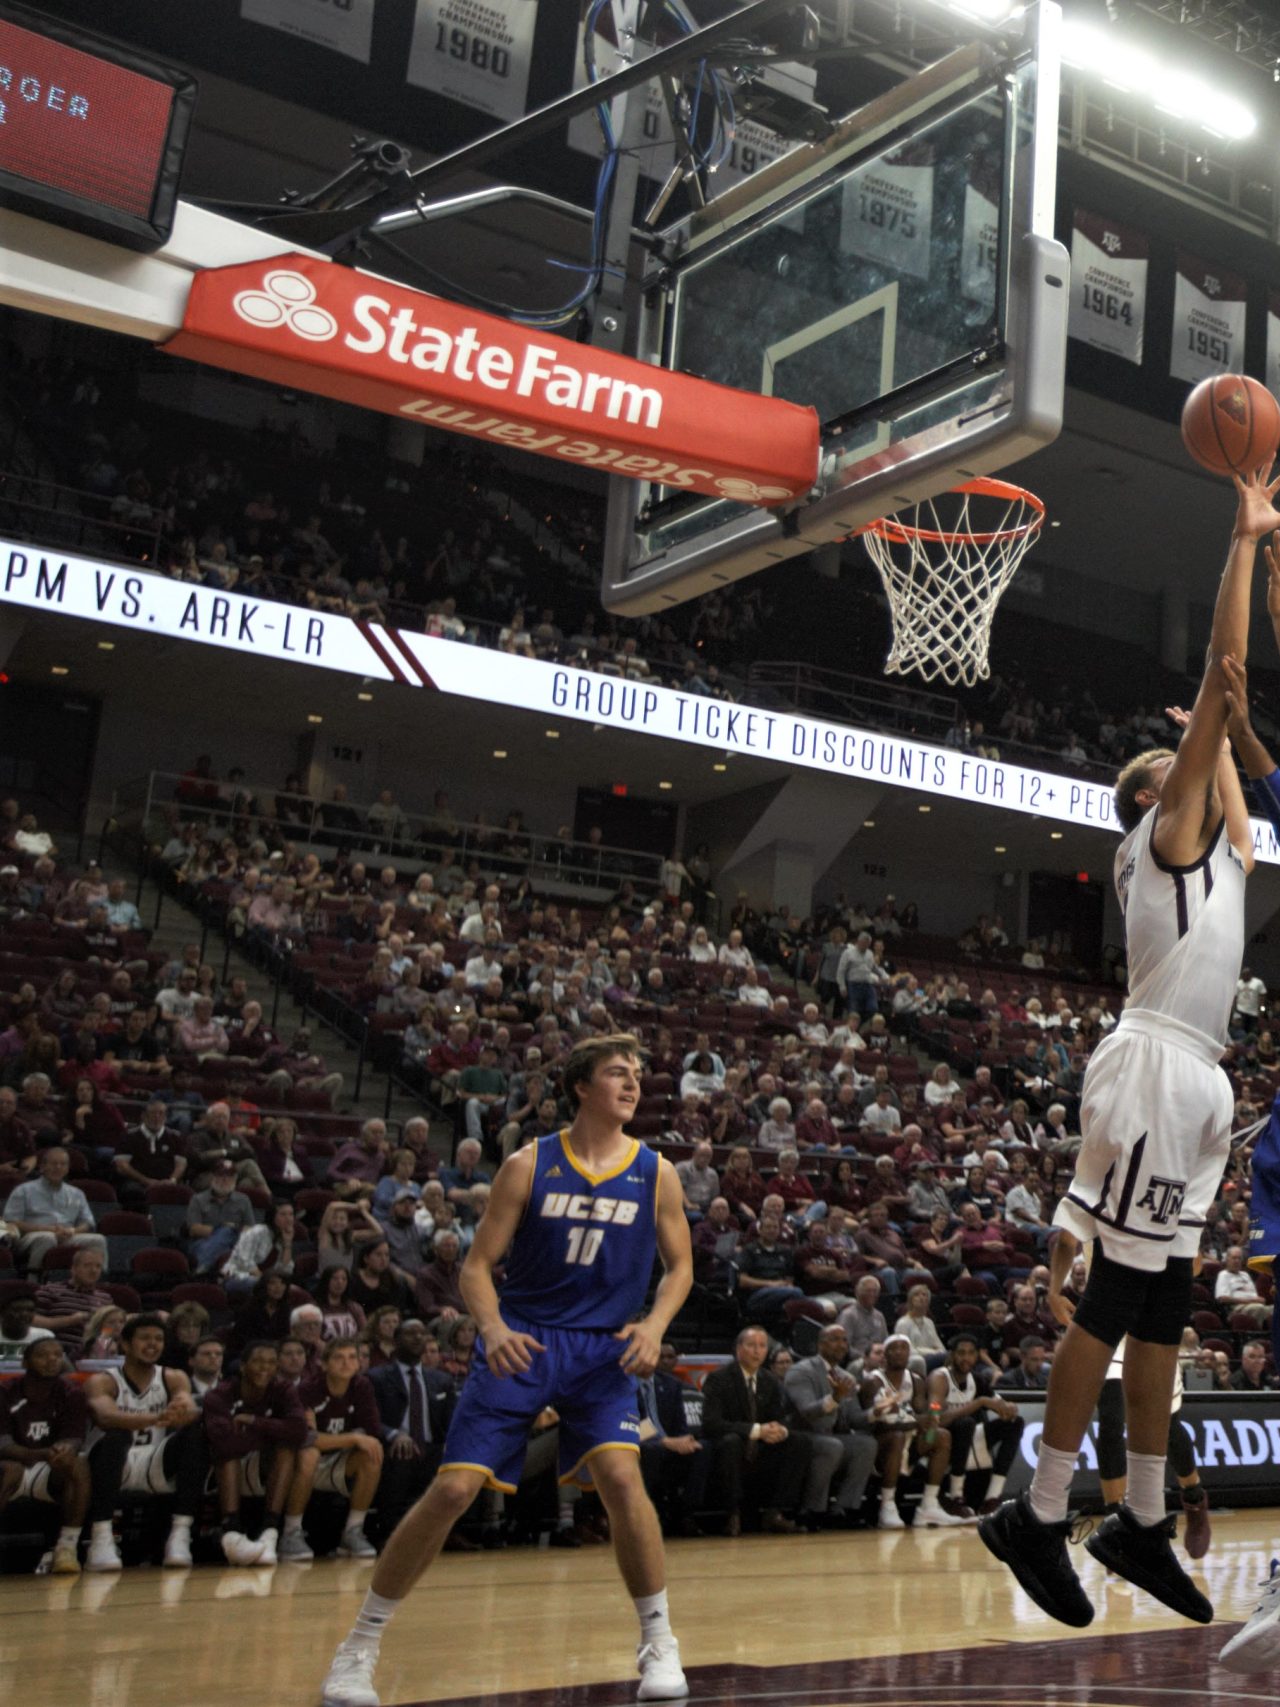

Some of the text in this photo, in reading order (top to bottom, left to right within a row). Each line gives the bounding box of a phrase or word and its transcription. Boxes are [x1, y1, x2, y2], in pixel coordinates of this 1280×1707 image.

[439, 7, 513, 45] CHAMPIONSHIP
[435, 21, 510, 78] 1980
[859, 194, 916, 239] 1975
[1085, 273, 1134, 299] CHAMPIONSHIP
[1089, 265, 1131, 289] CONFERENCE
[1082, 284, 1133, 327] 1964
[1191, 308, 1230, 330] CONFERENCE
[1188, 314, 1233, 340] CHAMPIONSHIP
[1188, 327, 1230, 366] 1951
[4, 551, 326, 657] PM VS. ARK-LR
[551, 670, 658, 725] GROUP
[674, 697, 777, 751] TICKET
[791, 723, 947, 787] DISCOUNTS
[960, 761, 1006, 800] FOR
[1018, 773, 1057, 808] 12+
[1069, 784, 1120, 824] PEO
[540, 1192, 640, 1226] UCSB
[565, 1226, 605, 1267] 10
